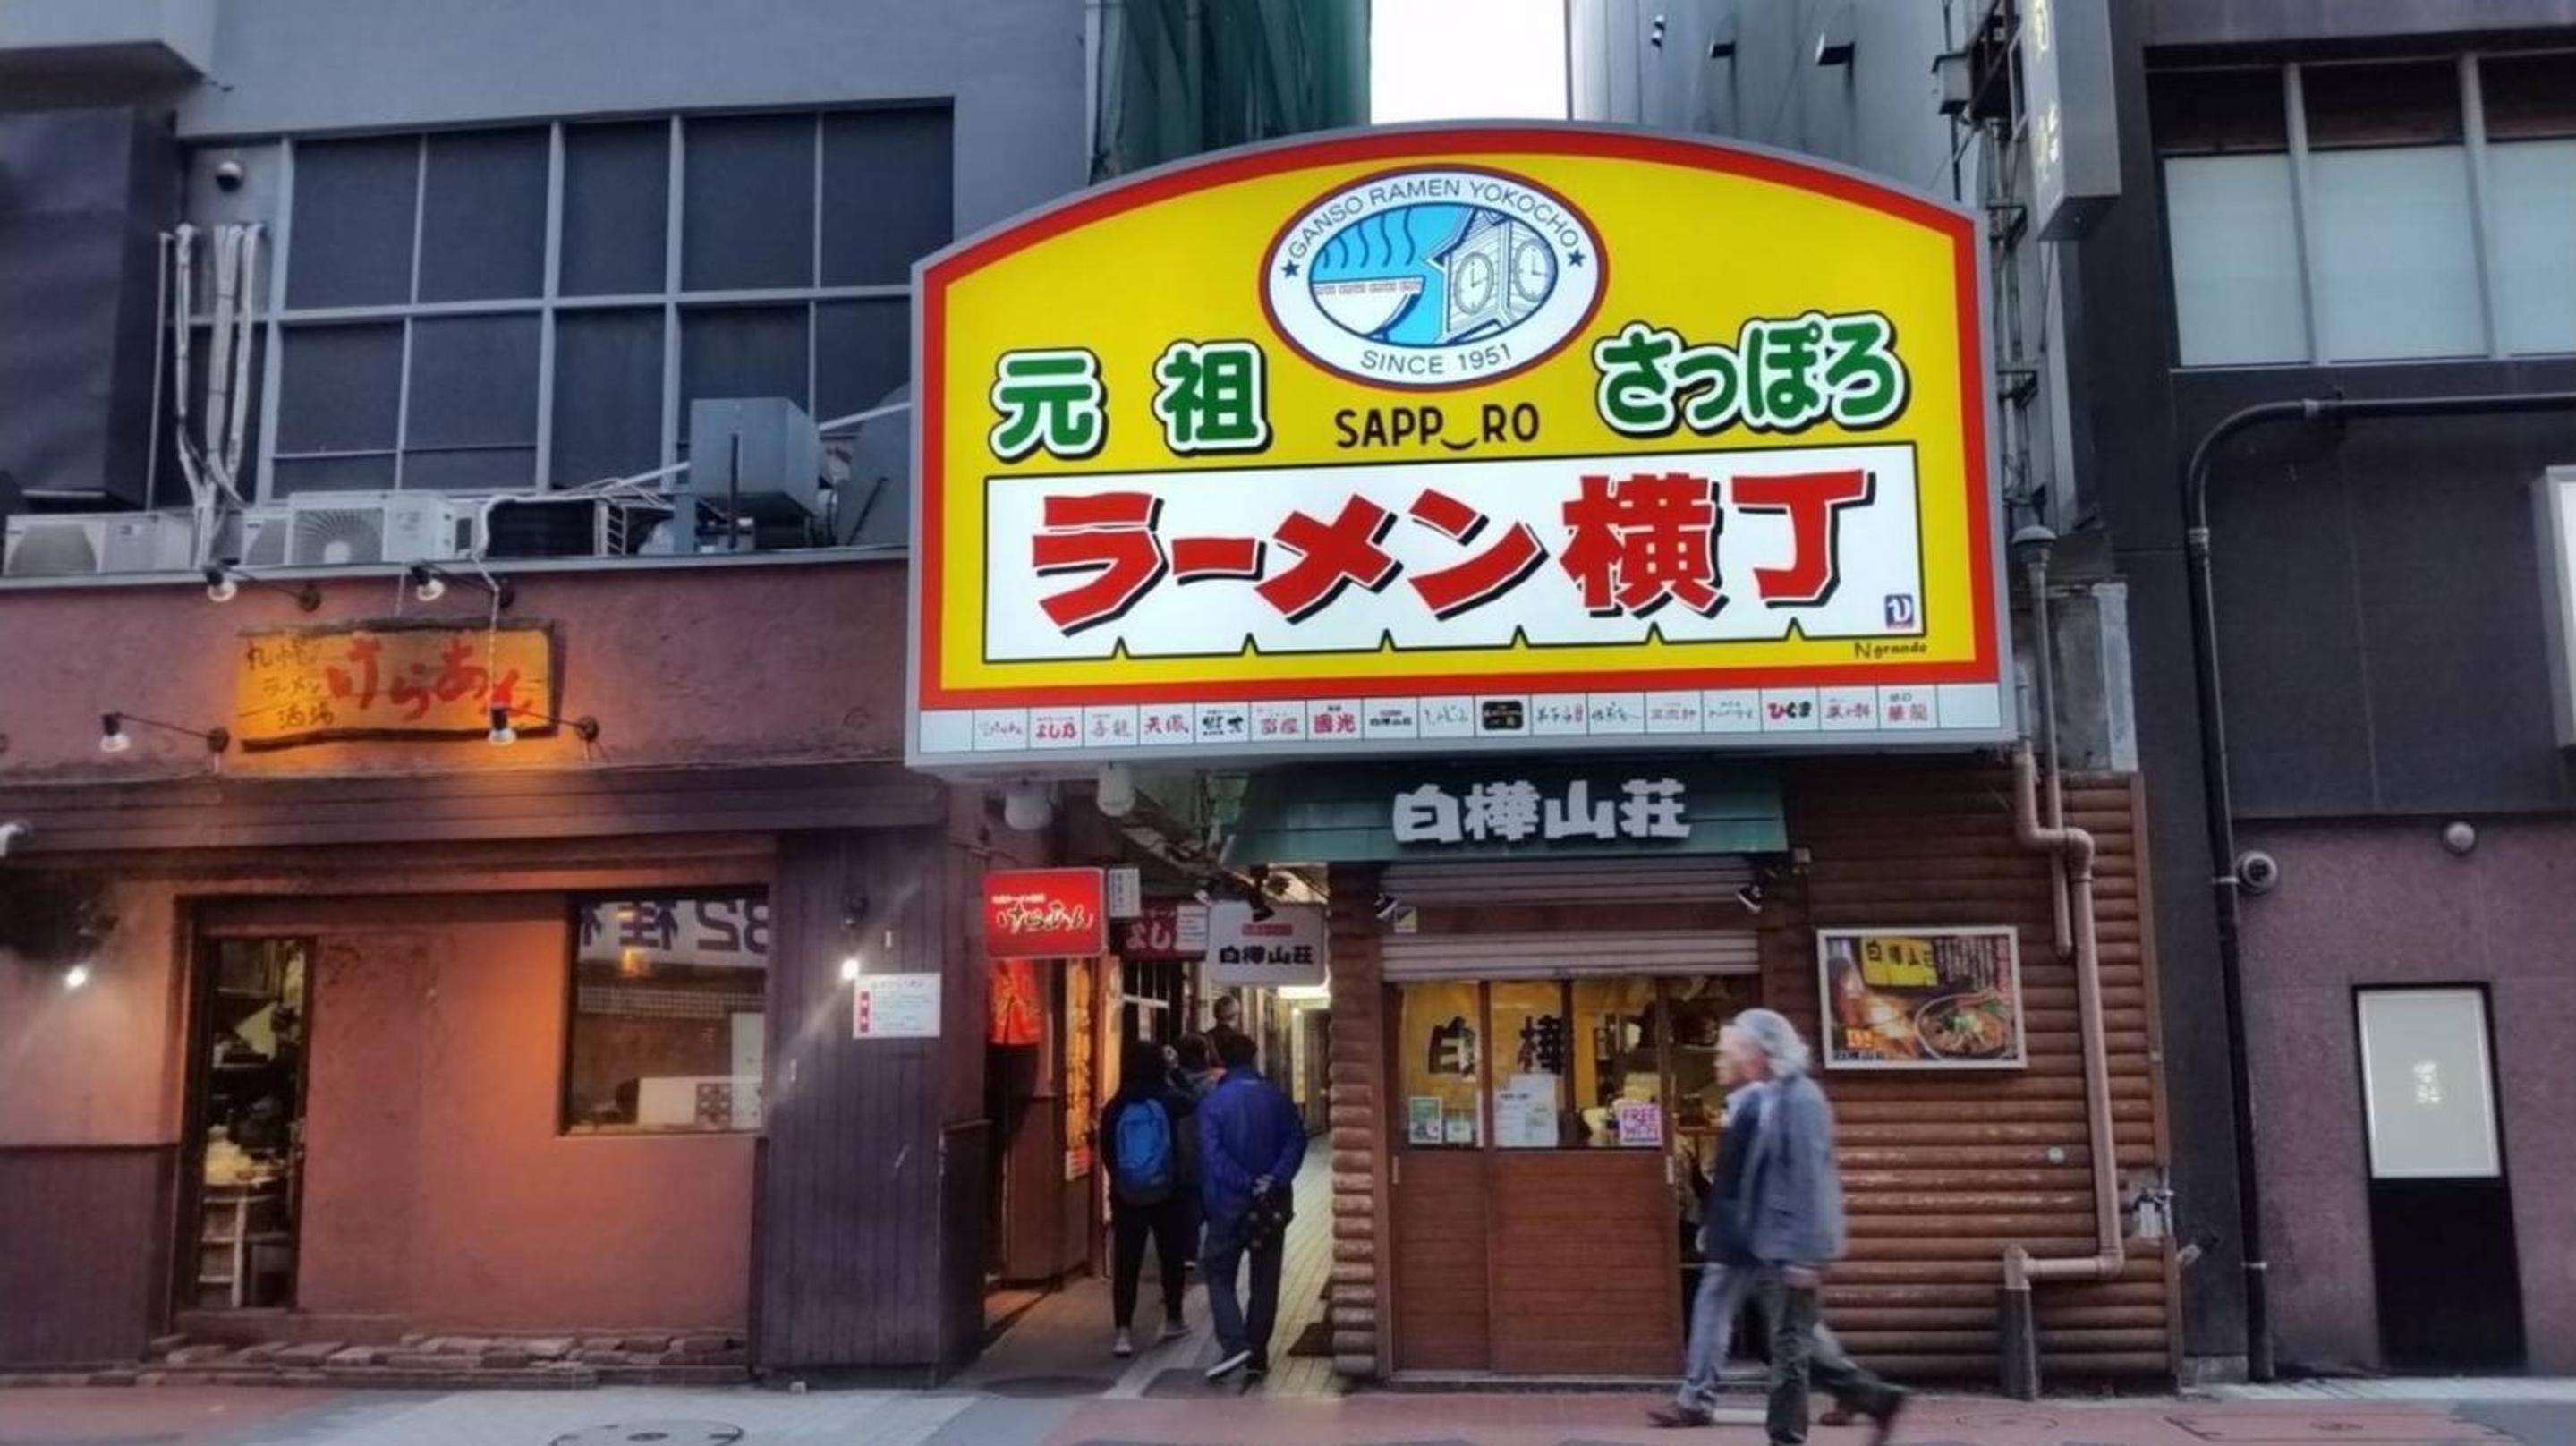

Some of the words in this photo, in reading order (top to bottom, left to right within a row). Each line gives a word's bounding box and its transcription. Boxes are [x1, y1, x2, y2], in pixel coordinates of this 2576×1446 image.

[1288, 195, 1365, 259] GANSO
[1370, 179, 1461, 207] RAMEN
[1471, 181, 1580, 249] YOKOCHO
[992, 344, 1265, 457] 元祖
[1360, 350, 1445, 375] SINCE
[1458, 344, 1512, 372] 1951
[1597, 316, 1902, 432] さっぽろ
[1031, 468, 1876, 634] ラーメン横丁
[1393, 779, 1692, 844] 白樺山荘
